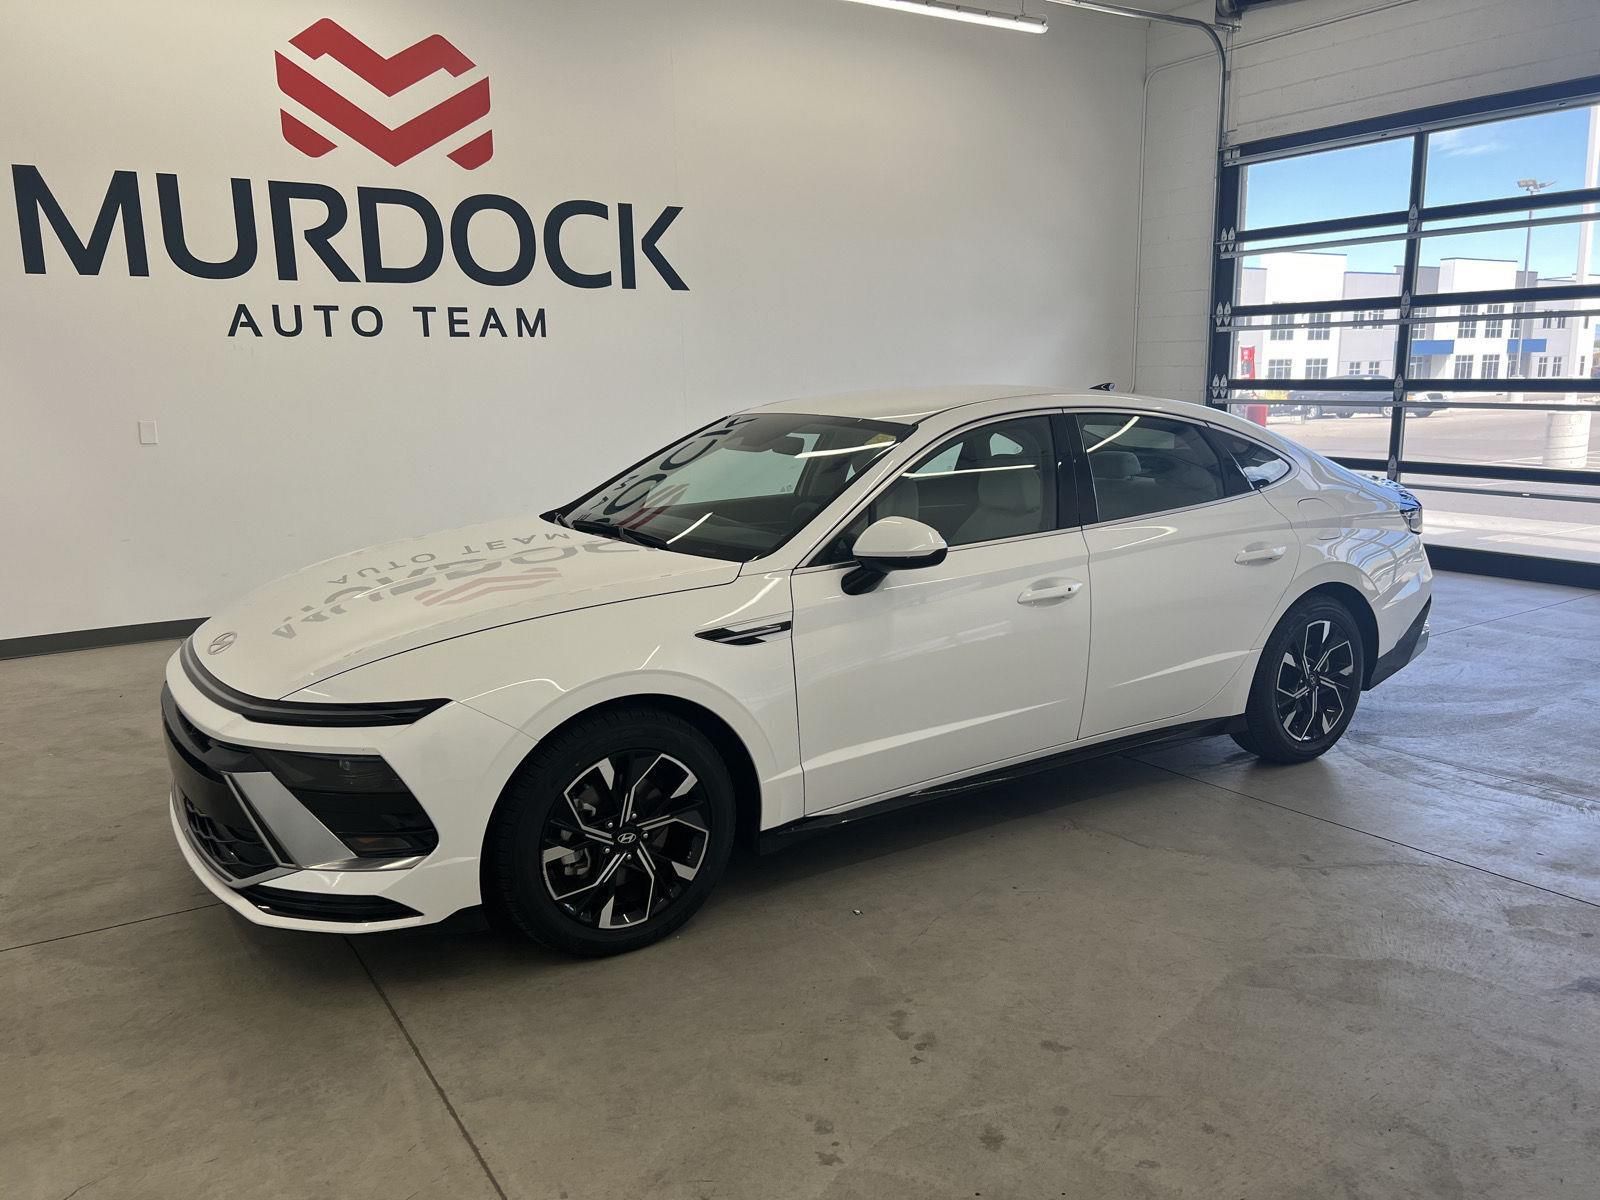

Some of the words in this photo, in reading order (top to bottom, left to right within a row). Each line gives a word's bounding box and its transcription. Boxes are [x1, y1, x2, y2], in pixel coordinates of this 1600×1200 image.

[11, 163, 690, 291] MURDOCK
[228, 303, 384, 338] AUTO
[412, 306, 547, 338] TEAM
